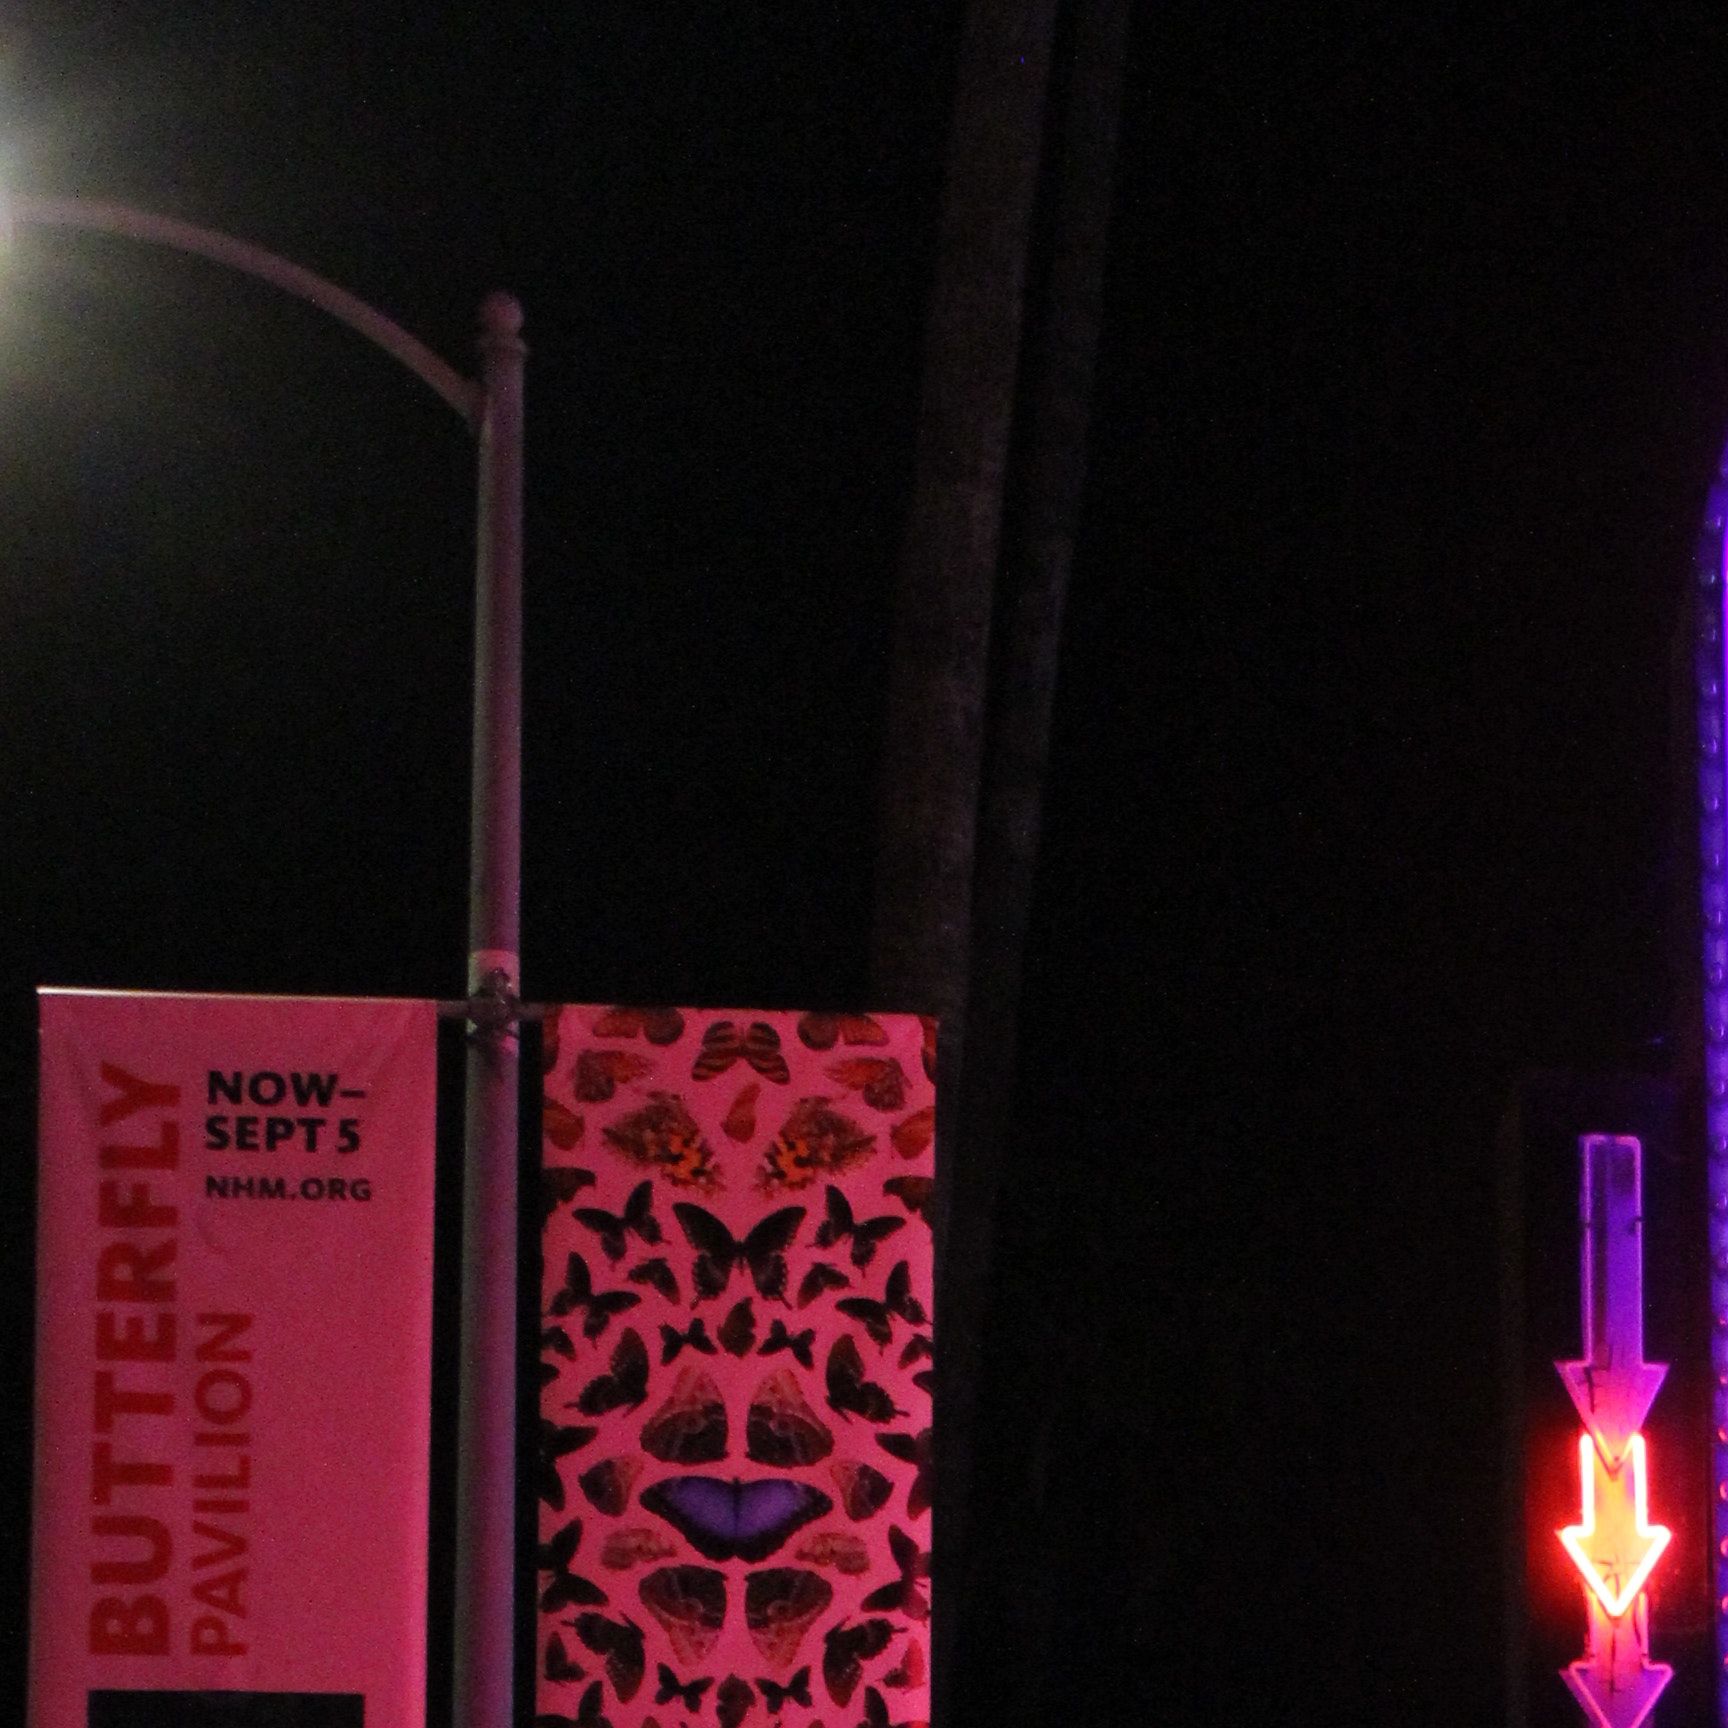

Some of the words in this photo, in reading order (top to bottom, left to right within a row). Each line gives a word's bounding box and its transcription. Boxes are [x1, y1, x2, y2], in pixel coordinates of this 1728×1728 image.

[205, 1116, 326, 1153] SEPT
[337, 1118, 360, 1154] 5
[205, 1174, 372, 1201] NHM.ORG
[88, 1060, 181, 1657] BUTTERFLY
[190, 1312, 254, 1657] PAVILION
